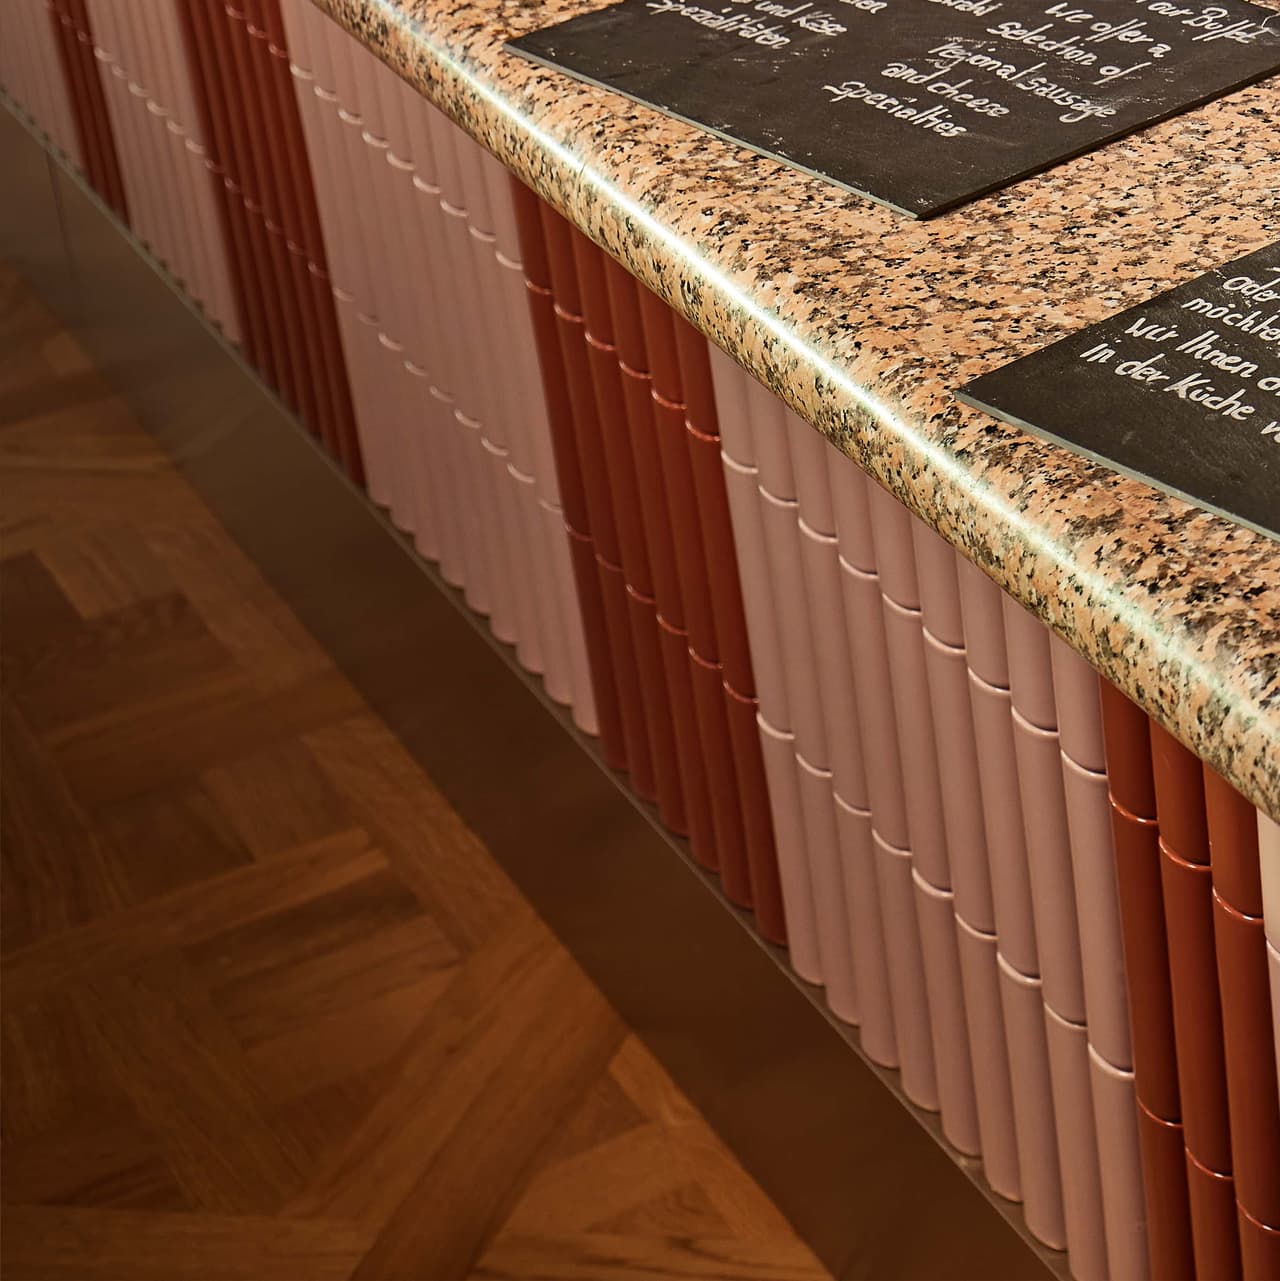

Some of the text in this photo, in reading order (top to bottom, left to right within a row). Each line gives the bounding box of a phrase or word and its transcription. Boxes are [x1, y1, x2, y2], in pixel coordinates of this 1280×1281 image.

[754, 0, 814, 18] und
[1148, 2, 1194, 16] our
[1085, 19, 1154, 43] offer
[1148, 43, 1171, 58] a
[881, 63, 1010, 117] and cheese
[928, 42, 1116, 123] regional sausage
[1093, 62, 1152, 85] of
[1124, 318, 1178, 341] wir
[1175, 330, 1258, 378] Ihnen
[1114, 353, 1170, 383] der
[1163, 372, 1256, 420] Küche
